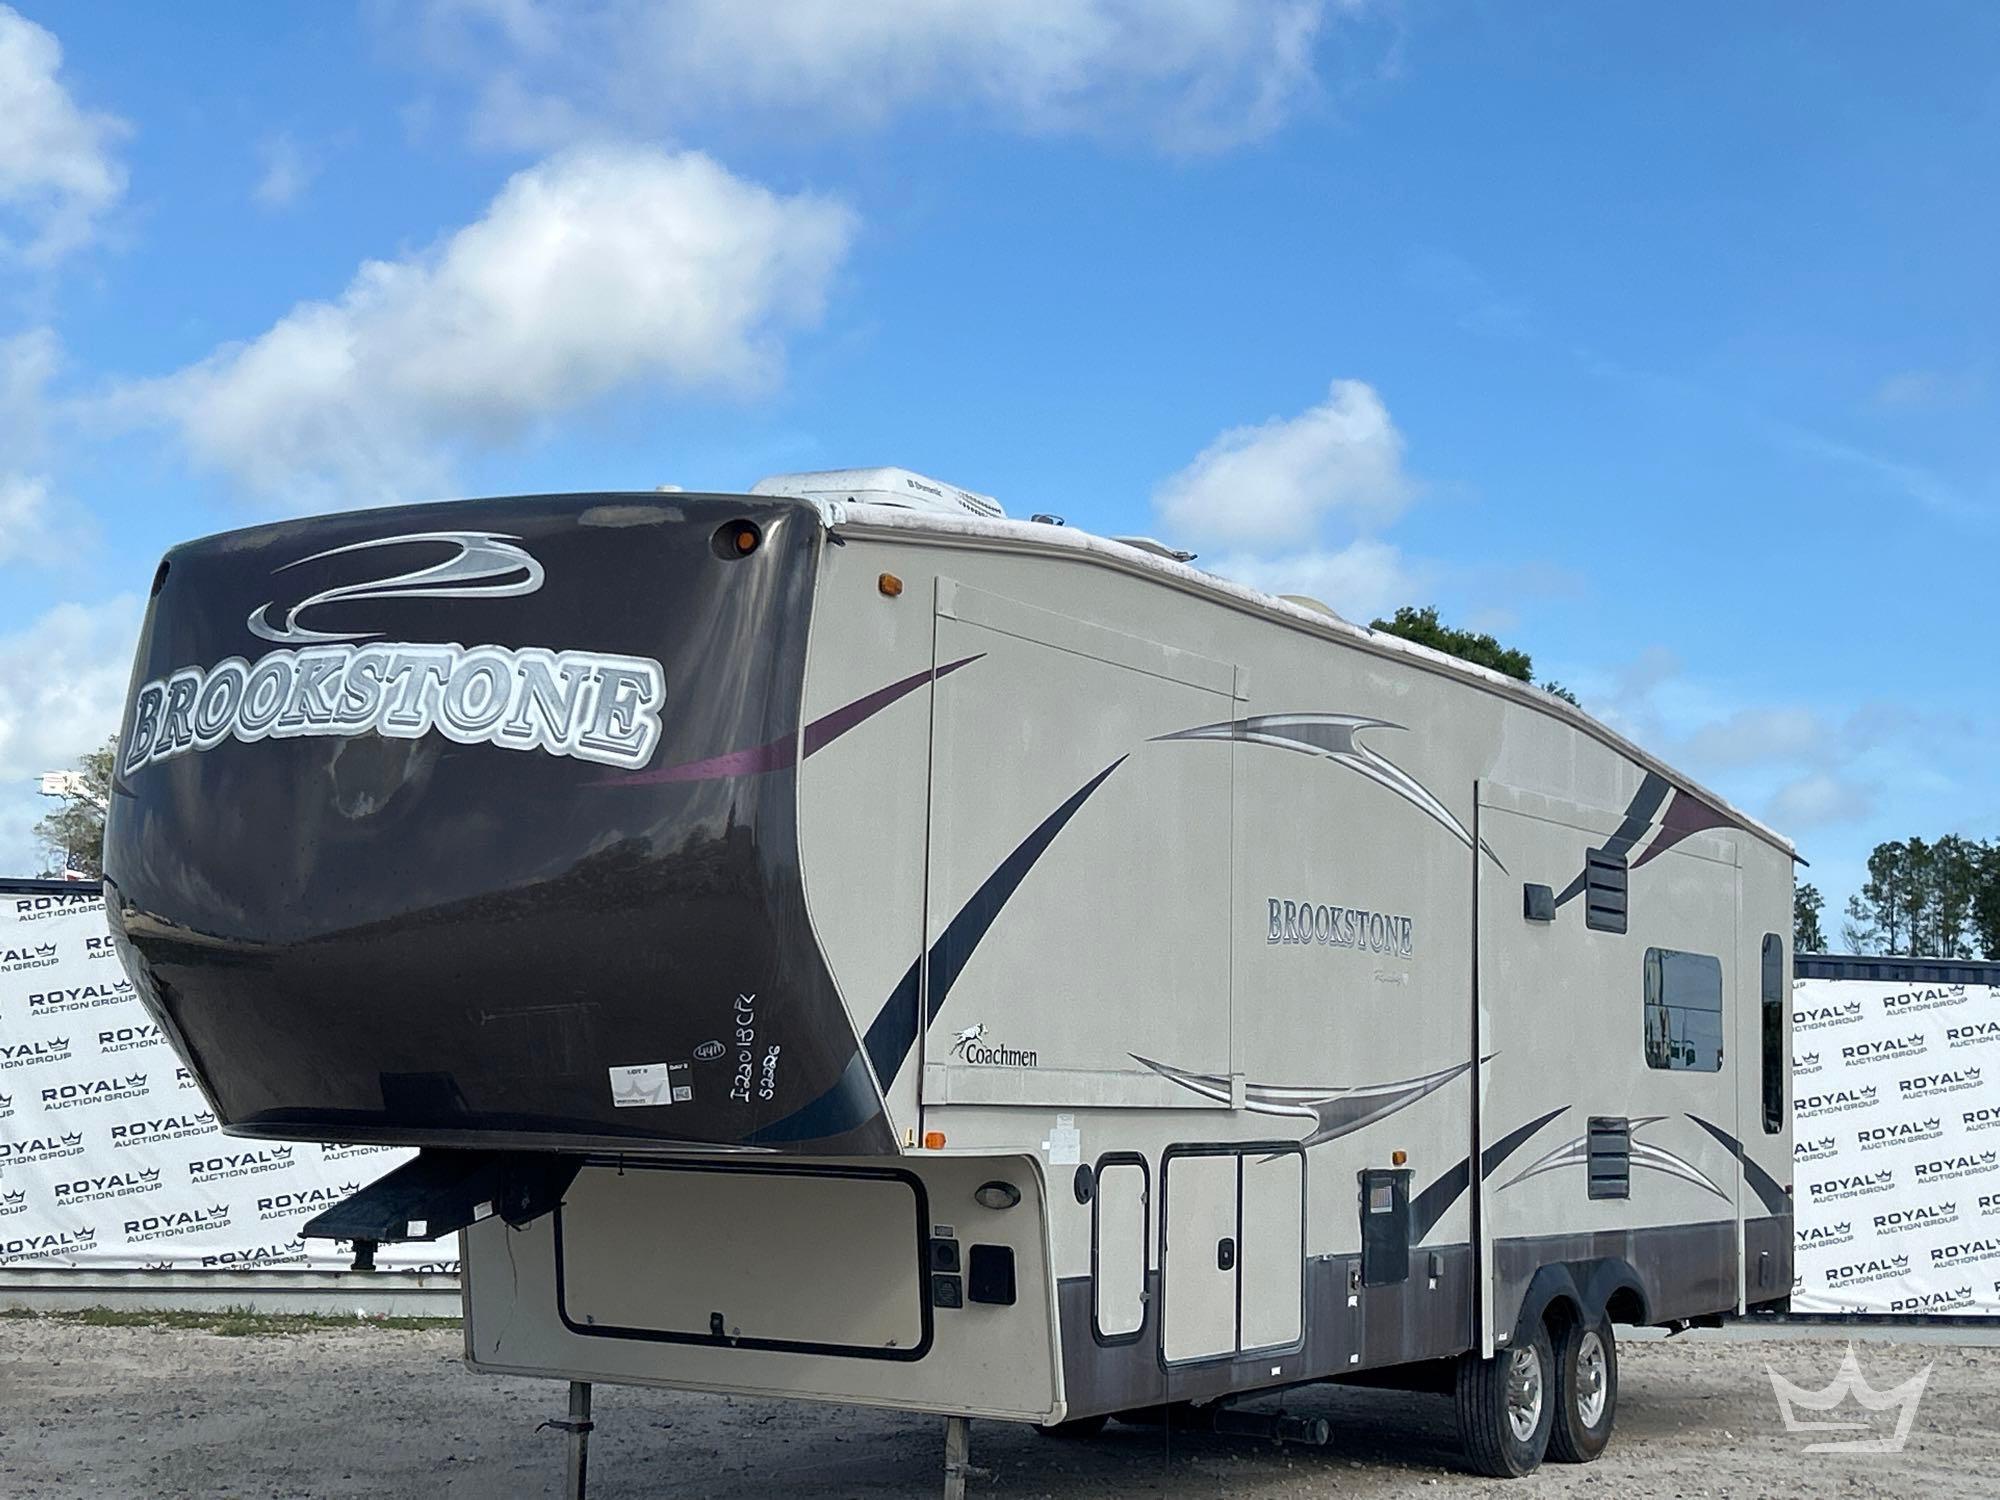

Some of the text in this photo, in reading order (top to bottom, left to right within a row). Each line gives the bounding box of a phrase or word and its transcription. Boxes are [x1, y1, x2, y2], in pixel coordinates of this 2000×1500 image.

[124, 645, 665, 771] BROOKSTONE
[19, 903, 106, 921] AUCTION GRO
[1267, 898, 1412, 960] BROOKSTONE
[14, 958, 59, 971] GROUP
[29, 984, 112, 1006] ROYAL
[31, 994, 137, 1016] AUCTION GROUP
[1883, 988, 1948, 1008] ROYAL
[1793, 1006, 1844, 1023] OYAL
[1886, 997, 1968, 1016] AUCTION GROUP
[1828, 1015, 1864, 1027] GROUP
[1946, 1022, 2000, 1040] ROYA
[0, 1043, 48, 1059] YAL
[101, 1039, 158, 1053] AUCTION
[1842, 1038, 1908, 1058] ROYAL
[1950, 1035, 1994, 1048] AUCTION
[26, 1052, 72, 1065] GROUP
[966, 1043, 1037, 1067] Coachmen
[1845, 1047, 1928, 1067] AUCTION GROUP
[1793, 1065, 1822, 1076] ROUP
[42, 1078, 125, 1101] ROYAL
[1899, 1071, 1965, 1091] ROYAL
[1902, 1080, 1984, 1100] AUCTION GROUP
[44, 1088, 150, 1111] AUCTION GROUP
[1793, 1090, 1860, 1110] ROYAL
[1796, 1098, 1879, 1119] AUCTION GROUP
[1962, 1107, 2000, 1123] ROY
[111, 1115, 194, 1139] ROYAL
[113, 1125, 219, 1149] AUCTION GROUP
[1858, 1122, 1923, 1142] ROYAL
[0, 1138, 60, 1157] OYAL
[1861, 1131, 1943, 1151] AUCTION GROUP
[39, 1146, 85, 1161] GROUP
[189, 1151, 271, 1174] ROYAL
[323, 1146, 379, 1161] AUCTION
[1802, 1150, 1838, 1162] GROUP
[191, 1161, 295, 1184] AUCTION GROUP
[1914, 1155, 1980, 1175] ROYAL
[1918, 1163, 1999, 1184] AUCTION GROUP
[55, 1173, 139, 1197] ROYAL
[57, 1182, 162, 1207] AUCTION GROUP
[1810, 1175, 1876, 1195] ROYAL
[1813, 1183, 1895, 1204] AUCTION GROUP
[257, 1187, 339, 1211] ROYAL
[124, 1209, 208, 1234] ROYAL
[260, 1204, 316, 1220] AUCTION
[1873, 1207, 1940, 1227] ROYAL
[126, 1218, 232, 1243] AUCTION GROUP
[1797, 1226, 1835, 1241] YAL
[1876, 1215, 1959, 1236] AUCTION GROUP
[0, 1232, 74, 1255] OYAL
[51, 1242, 97, 1257] GROUP
[1818, 1235, 1854, 1247] GROUP
[1931, 1240, 1997, 1260] ROYAL
[201, 1245, 284, 1267] ROYAL
[263, 1253, 308, 1267] GROUP
[1934, 1256, 1979, 1268] AUCTION
[1826, 1260, 1892, 1280] ROYAL
[1829, 1268, 1911, 1289] AUCTION GROUP
[1891, 1291, 1956, 1311] ROYAL
[1940, 1300, 1975, 1311] GROUP
